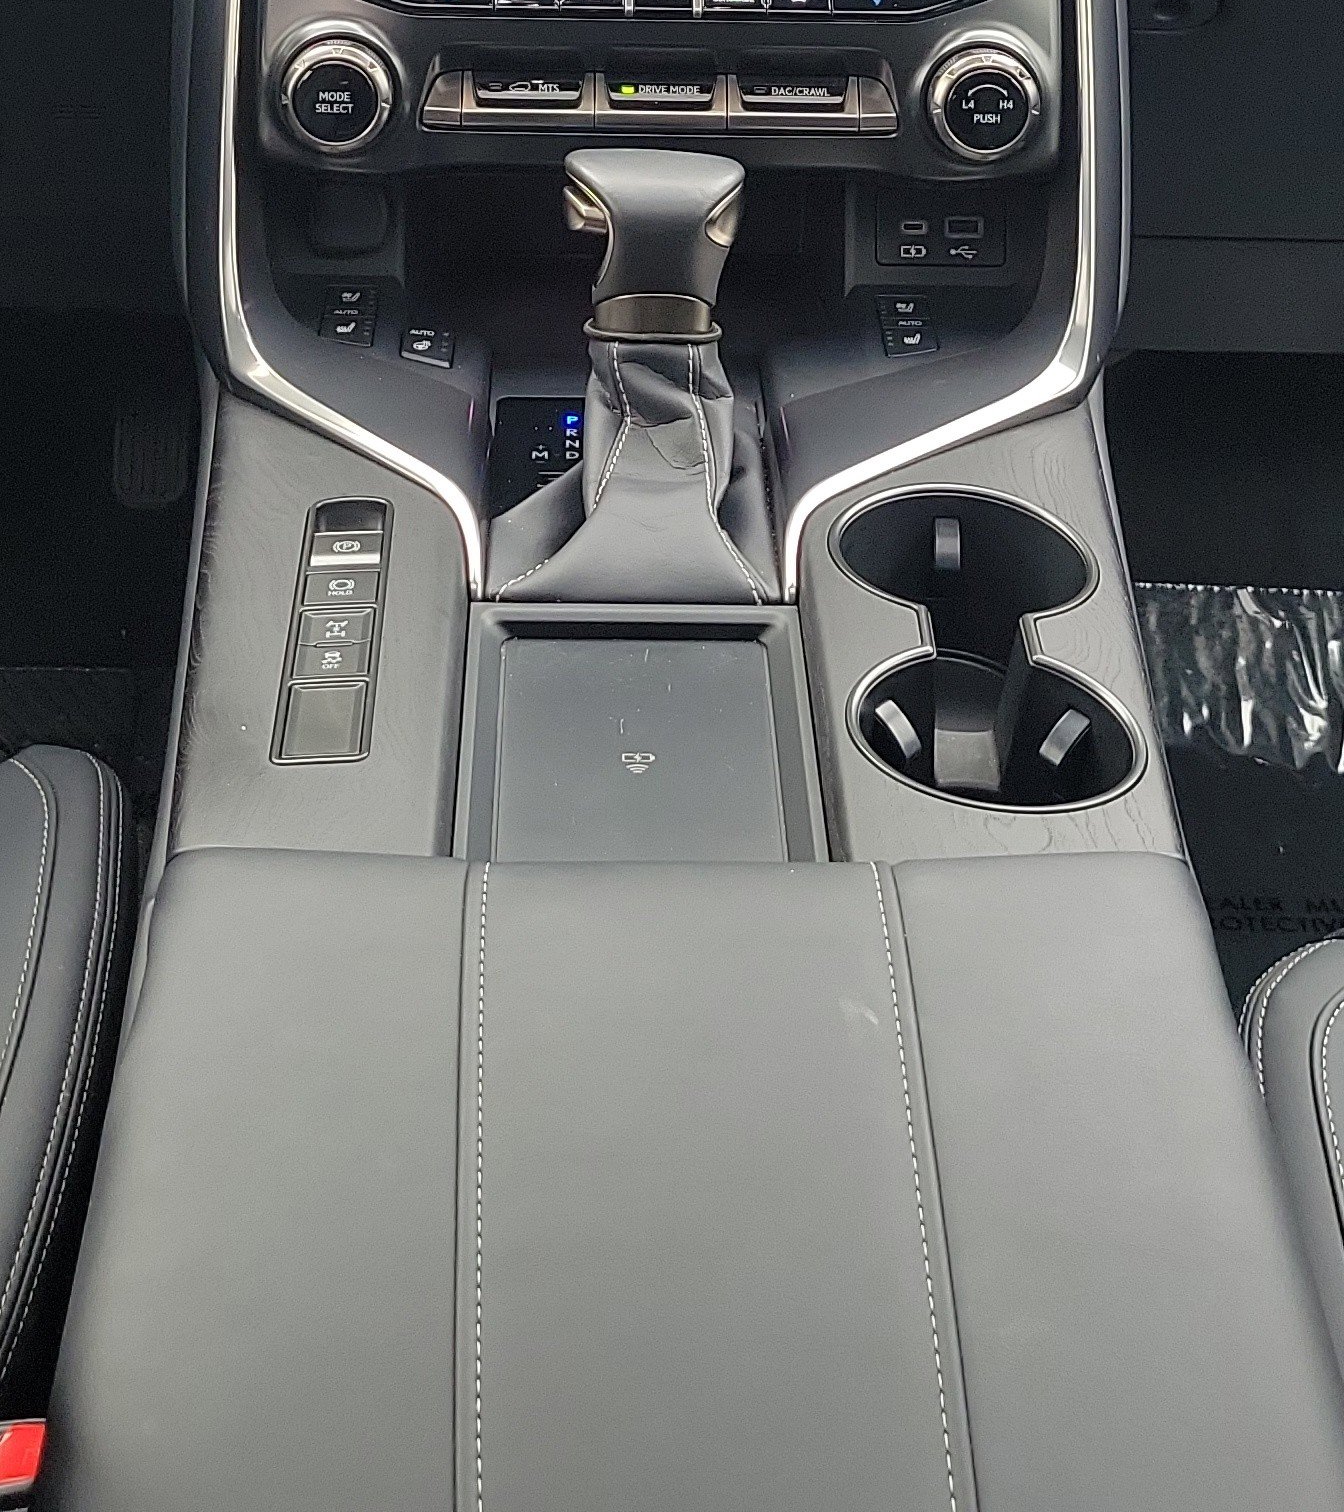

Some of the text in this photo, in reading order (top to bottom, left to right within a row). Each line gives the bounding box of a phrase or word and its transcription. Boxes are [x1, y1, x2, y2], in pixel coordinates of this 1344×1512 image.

[538, 83, 560, 94] MTS
[638, 84, 701, 95] DRIVE MODE
[771, 87, 831, 97] DAC/CRAWL
[318, 91, 351, 102] MODE
[315, 103, 354, 114] SELECT
[962, 99, 975, 110] L4
[999, 99, 1014, 110] H4
[973, 113, 1001, 124] PUSH
[409, 329, 436, 337] AUTO
[566, 415, 579, 425] P
[565, 428, 579, 437] R
[565, 439, 580, 449] N
[531, 450, 549, 460] M
[565, 450, 580, 460] D
[321, 662, 341, 670] OFF
